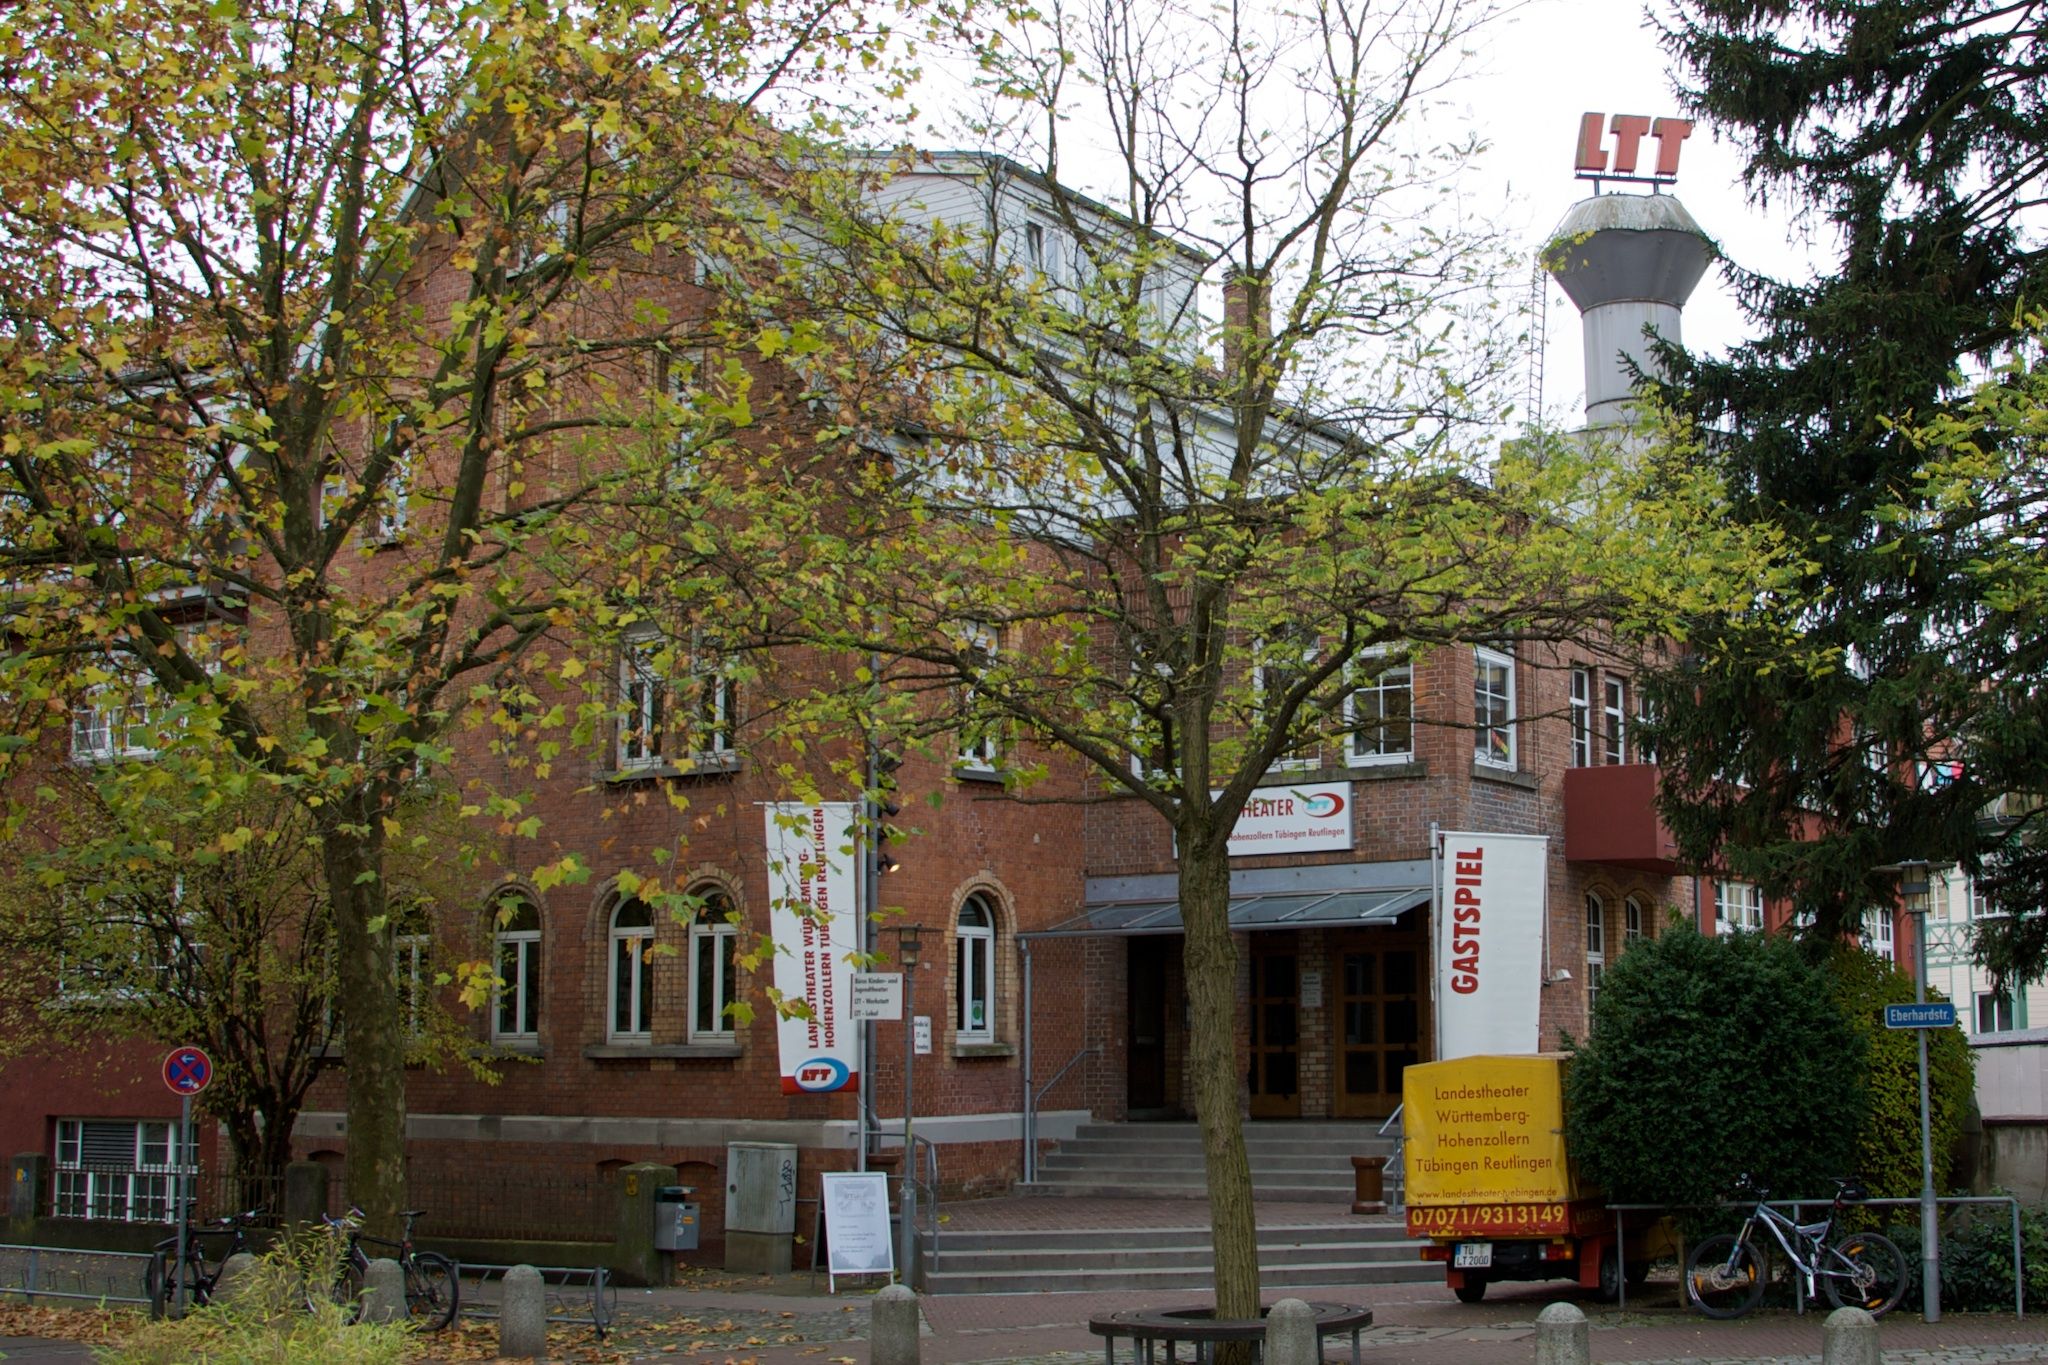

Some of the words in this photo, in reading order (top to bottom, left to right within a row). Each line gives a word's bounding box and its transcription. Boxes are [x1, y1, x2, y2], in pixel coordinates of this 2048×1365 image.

[1575, 112, 1694, 175] LTT
[1275, 829, 1307, 840] Tübingen
[1309, 826, 1345, 838] Reutlingen
[1451, 847, 1484, 995] GASTSPIEL
[821, 952, 835, 1048] HOHENZOLLERN
[1890, 1008, 1950, 1022] Eberhardstr.
[801, 1068, 832, 1082] LTT
[1435, 1084, 1530, 1101] Landestheater
[1436, 1107, 1531, 1125] Württemberg-
[1438, 1130, 1530, 1148] Hohenzollern
[1416, 1156, 1479, 1175] Tübingen
[1484, 1155, 1552, 1173] Reutlingen
[1411, 1204, 1565, 1226] 07071/9313149
